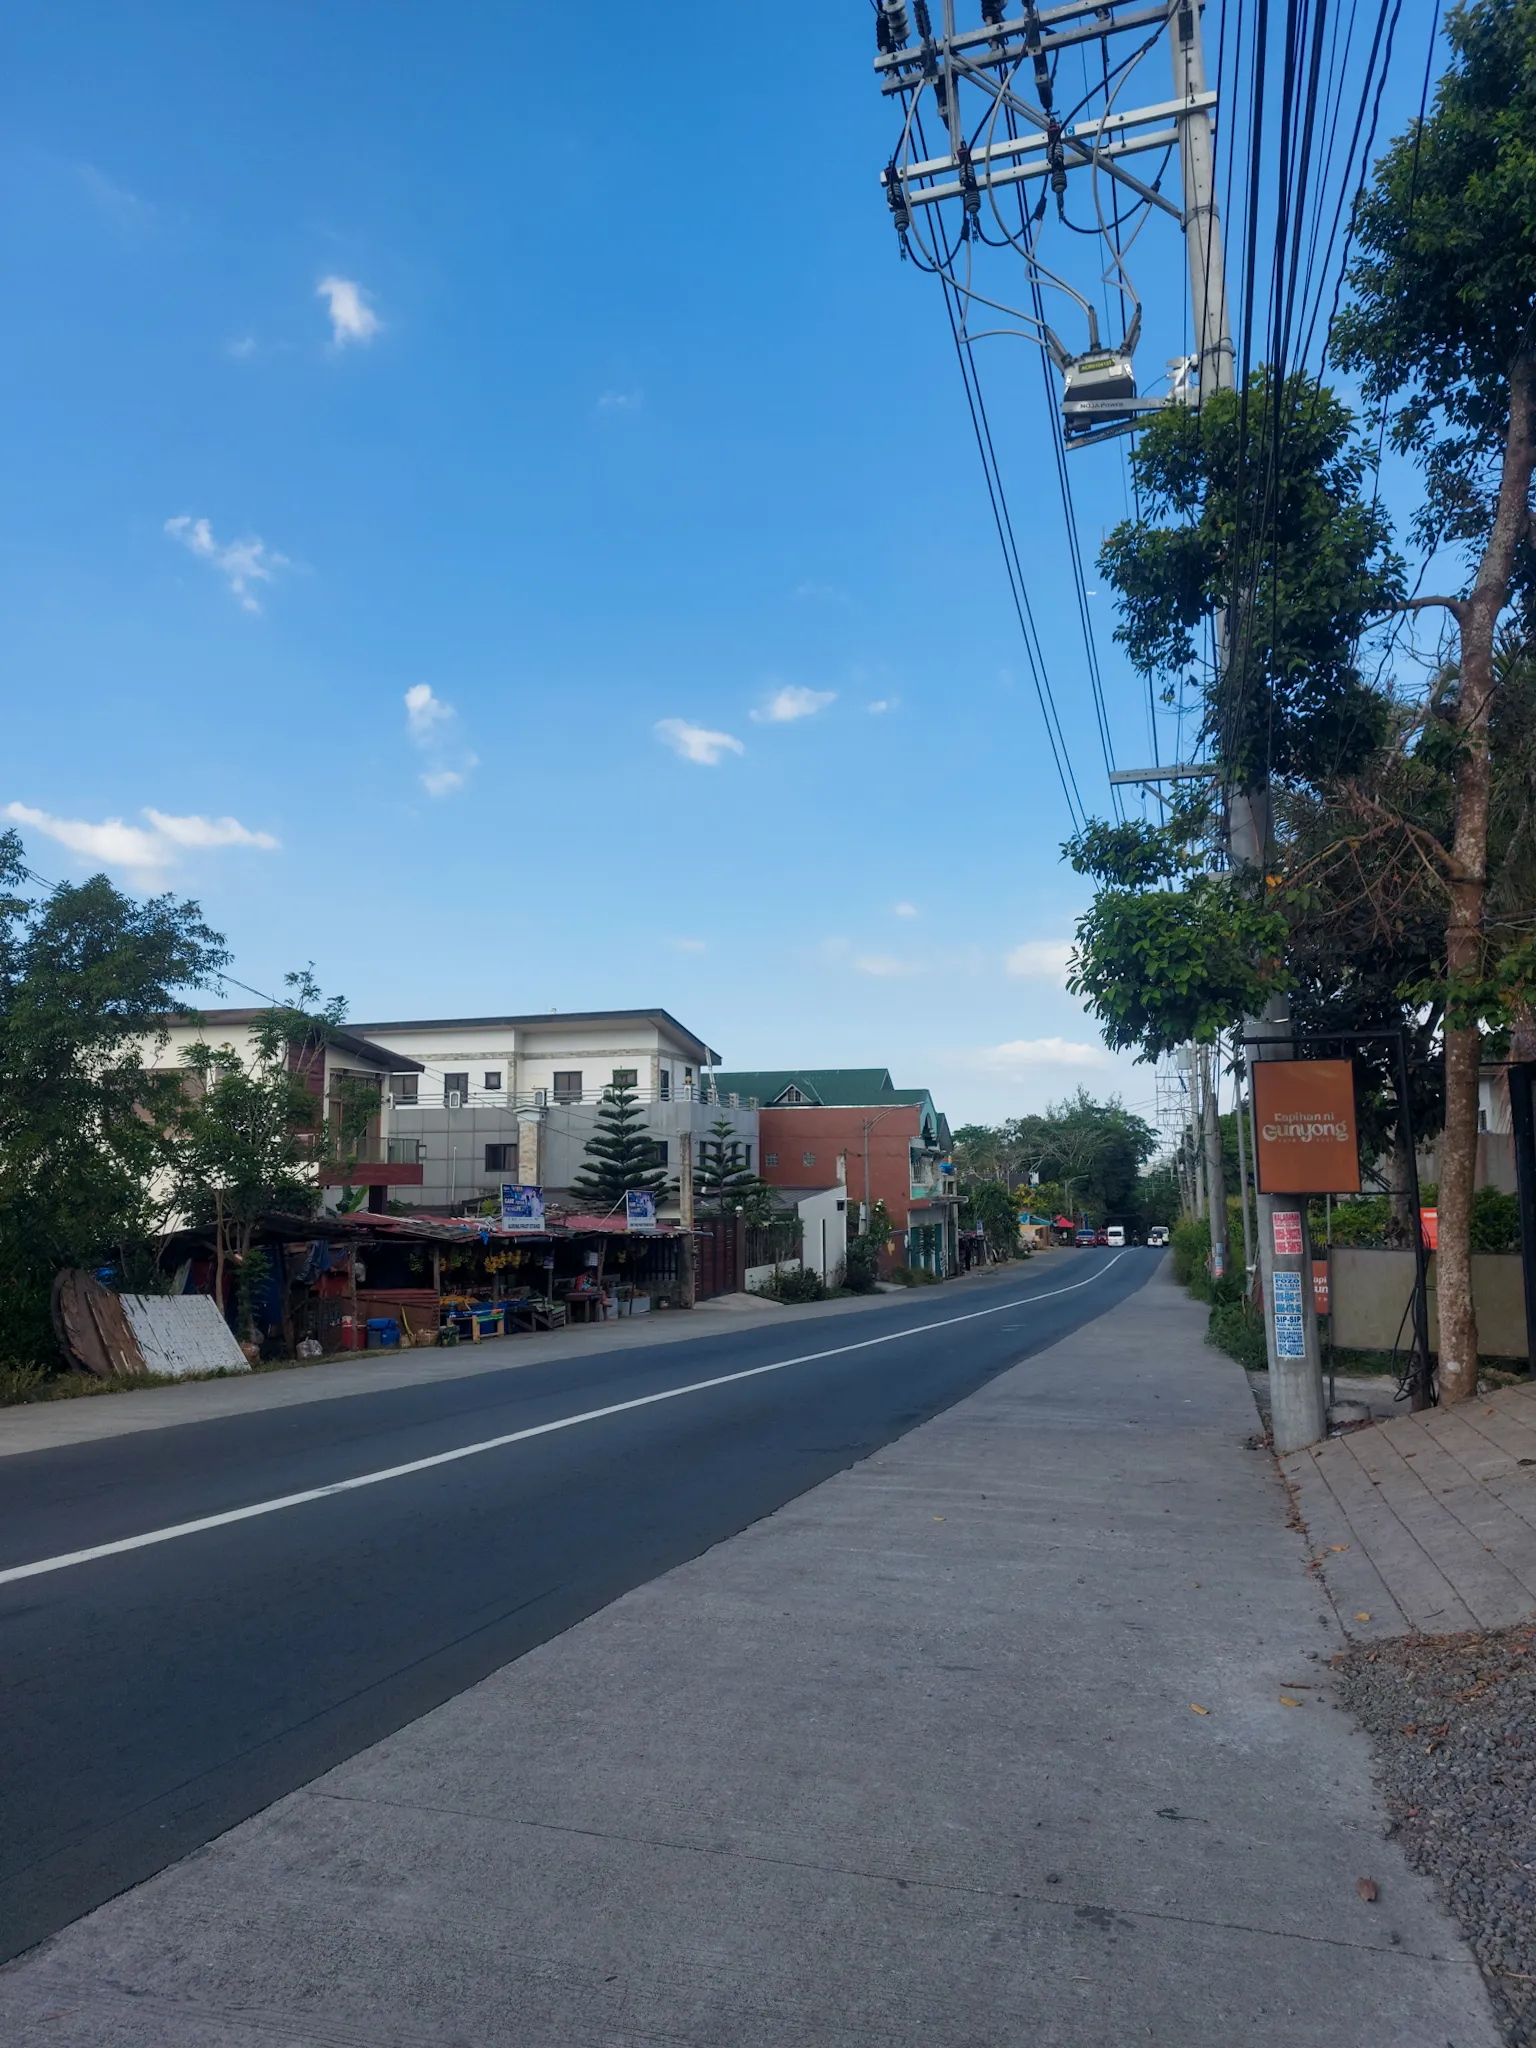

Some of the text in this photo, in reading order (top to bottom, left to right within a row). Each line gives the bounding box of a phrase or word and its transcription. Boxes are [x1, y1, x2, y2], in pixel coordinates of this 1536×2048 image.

[1066, 127, 1073, 136] C
[1274, 1112, 1335, 1123] Kapihan ni
[1262, 1120, 1349, 1143] Gunyong
[1276, 1315, 1301, 1323] SIP-SIP
